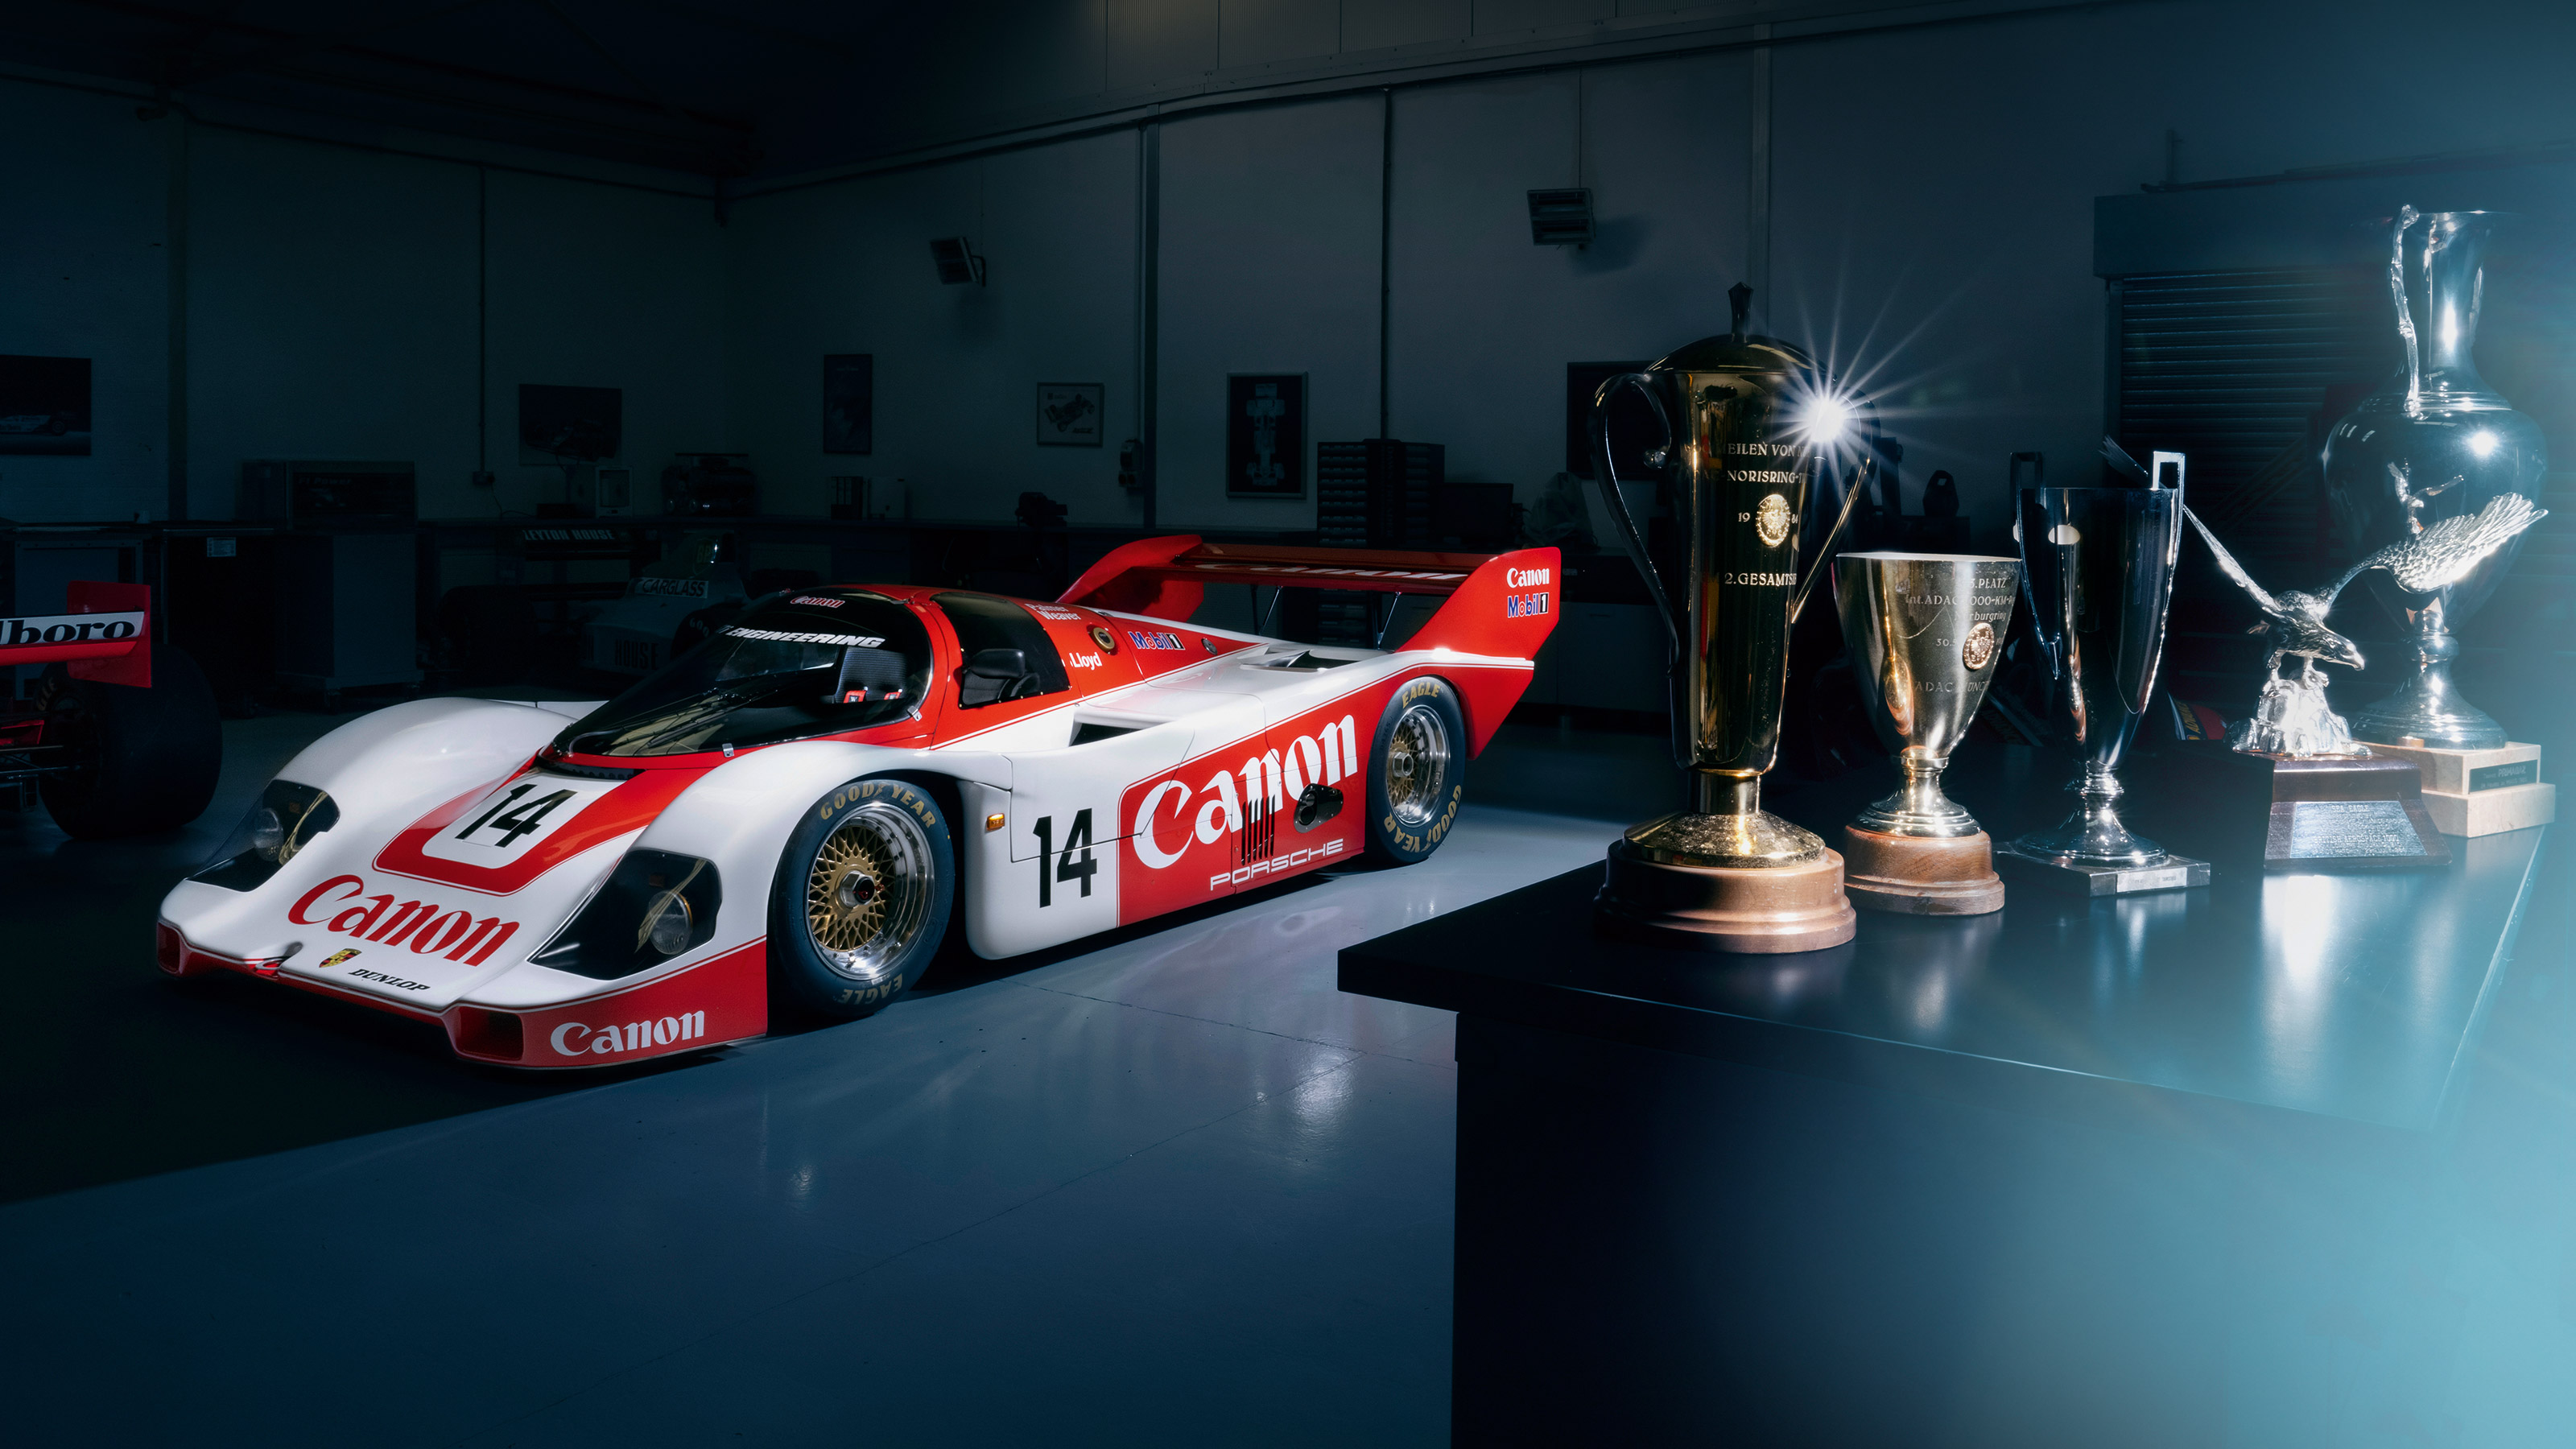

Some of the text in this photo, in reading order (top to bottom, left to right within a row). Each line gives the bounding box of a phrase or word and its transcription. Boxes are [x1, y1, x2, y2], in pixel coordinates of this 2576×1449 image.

[1727, 443, 1768, 456] EILEN
[1772, 444, 1796, 456] VON
[1738, 512, 1750, 523] 19
[571, 528, 616, 540] HOUSE
[642, 579, 705, 597] CARGLASS
[1506, 568, 1550, 588] Canon
[789, 595, 846, 609] Canon
[1024, 603, 1069, 612] Palmer
[1508, 592, 1549, 618] Mobil 1
[1036, 610, 1082, 620] Weaver
[0, 619, 135, 644] boro
[724, 627, 886, 648] ENGINEERING
[1128, 630, 1170, 650] Mobil
[615, 638, 660, 671] HOUSE
[1069, 651, 1103, 671] Lloyd
[1402, 681, 1441, 709] EAGLE
[1132, 714, 1358, 869] Canon
[454, 783, 579, 848] 14
[1032, 807, 1097, 908] 14
[1210, 838, 1344, 891] PORSCHE
[287, 874, 520, 967] Canon
[348, 968, 431, 990] DUNLOP
[843, 972, 903, 1005] EAGLE
[551, 1009, 704, 1057] Canon
